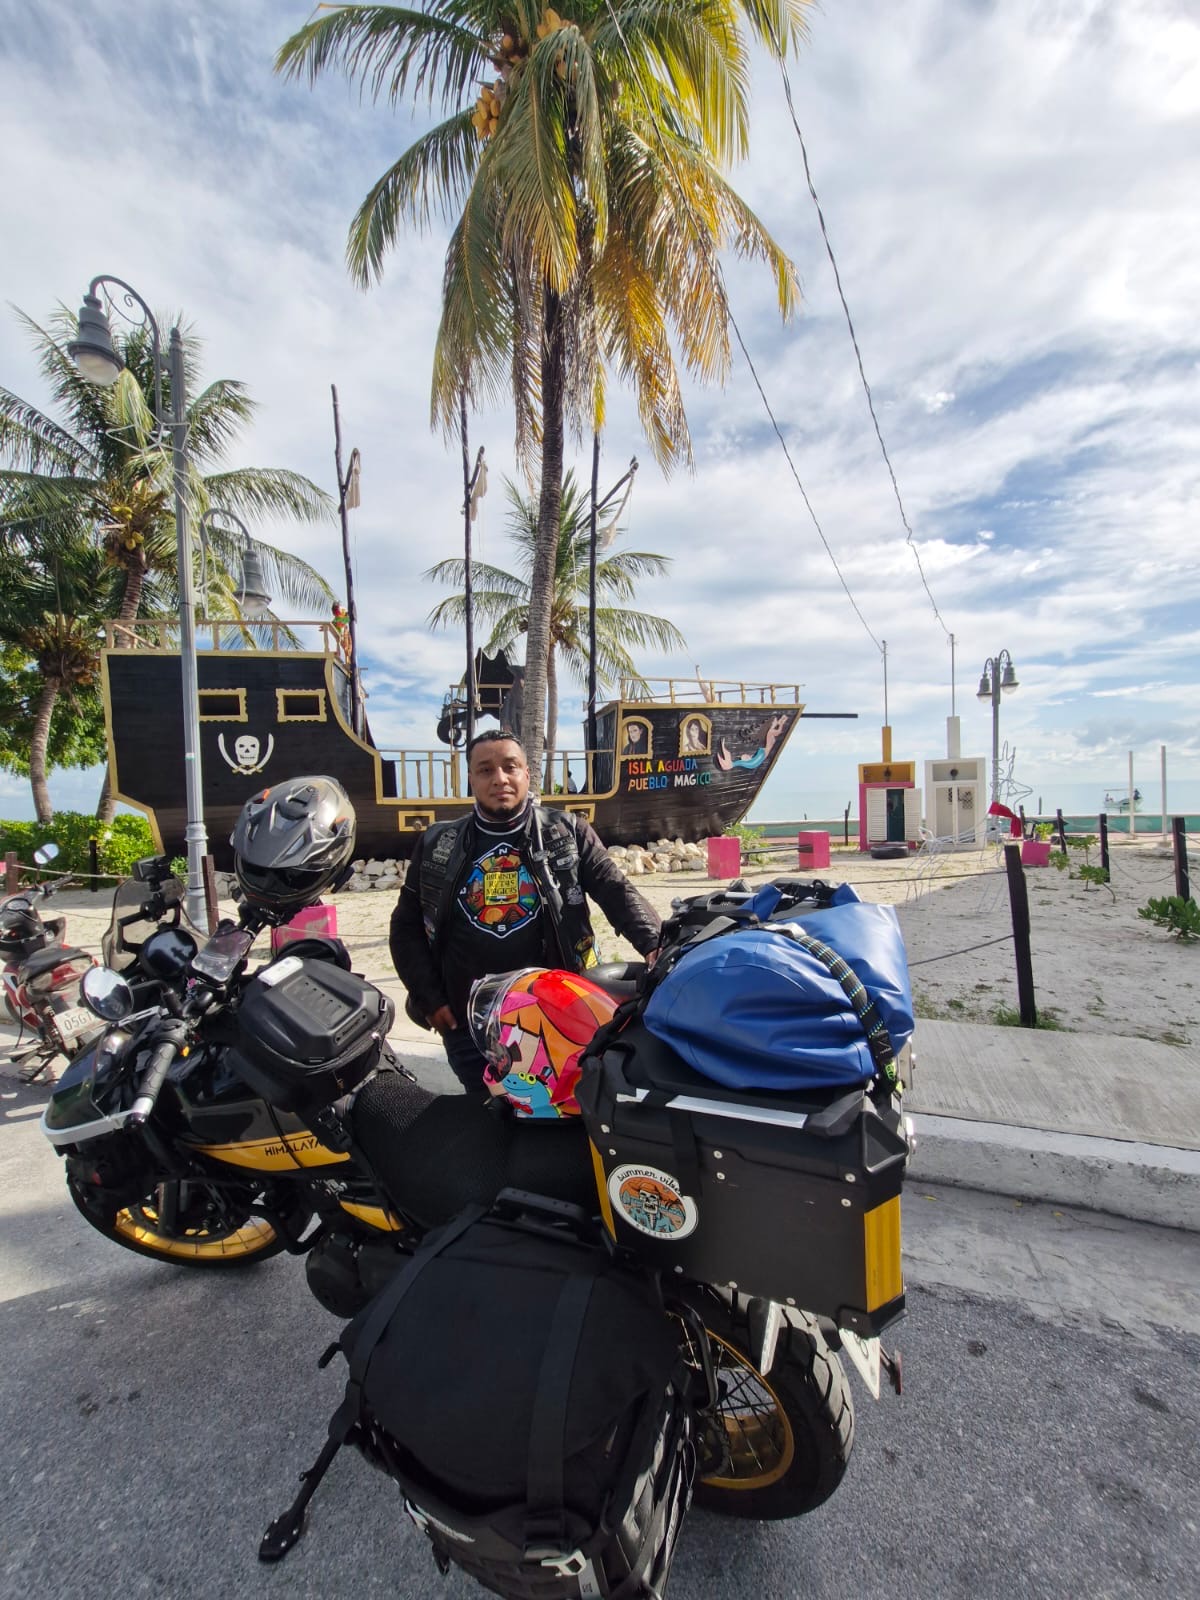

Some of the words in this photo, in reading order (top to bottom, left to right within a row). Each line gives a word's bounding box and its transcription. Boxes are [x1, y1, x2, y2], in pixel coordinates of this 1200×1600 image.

[628, 760, 653, 775] ISLA
[657, 758, 698, 773] AGUADA
[628, 775, 668, 792] PUEBLO
[673, 771, 711, 788] MAGICO
[498, 847, 508, 855] N
[497, 924, 507, 932] S
